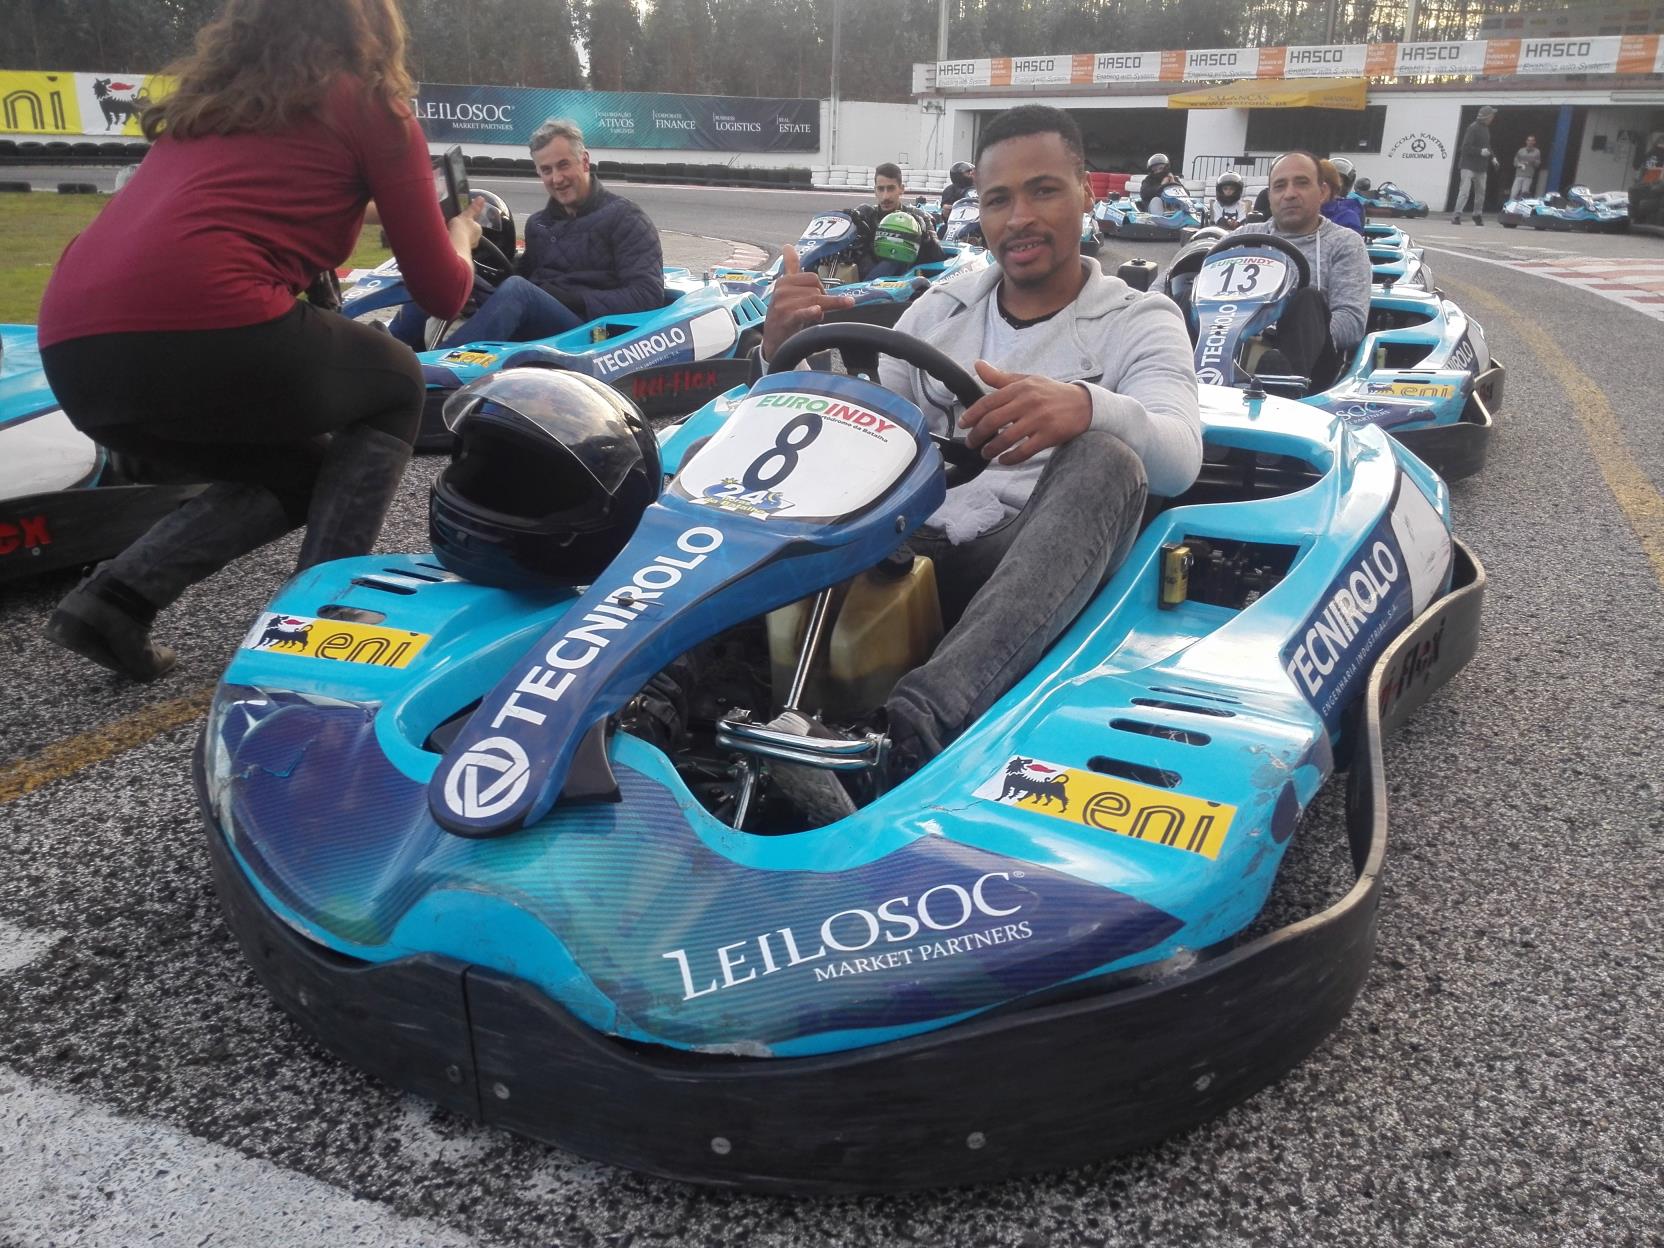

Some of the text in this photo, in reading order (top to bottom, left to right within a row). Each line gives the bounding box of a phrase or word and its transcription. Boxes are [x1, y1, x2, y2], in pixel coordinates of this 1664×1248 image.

[1190, 54, 1237, 66] HASCO
[1289, 50, 1342, 63] HASCO
[1402, 46, 1460, 60] HASCO
[1526, 42, 1591, 57] HASCO
[939, 63, 975, 75] HASCO
[1015, 60, 1054, 72] HASCO
[1098, 57, 1141, 69] HASCO
[1, 76, 67, 130] ni
[410, 98, 512, 122] LEILOSOC
[600, 118, 634, 128] ATIVOS
[656, 119, 696, 129] FINANCE
[716, 122, 761, 132] LOGISTICS
[780, 123, 811, 133] ESTATE
[808, 220, 838, 236] 27
[1219, 263, 1260, 293] 13
[593, 327, 686, 375] TECNIROLO
[1400, 384, 1450, 398] eni
[755, 395, 898, 434] EUROINDY
[852, 423, 862, 431] da
[862, 427, 888, 443] Batalha
[742, 412, 824, 493] 8
[713, 483, 769, 505] 24
[490, 526, 724, 729] TECNIROLO
[1286, 541, 1399, 697] TECNIROLO
[315, 631, 420, 668] eni
[1322, 663, 1357, 717] ENGENHARIA
[1082, 790, 1222, 853] eni
[662, 871, 1022, 1001] LEILOSOC
[813, 920, 1034, 983] MARKET PARTNERS
